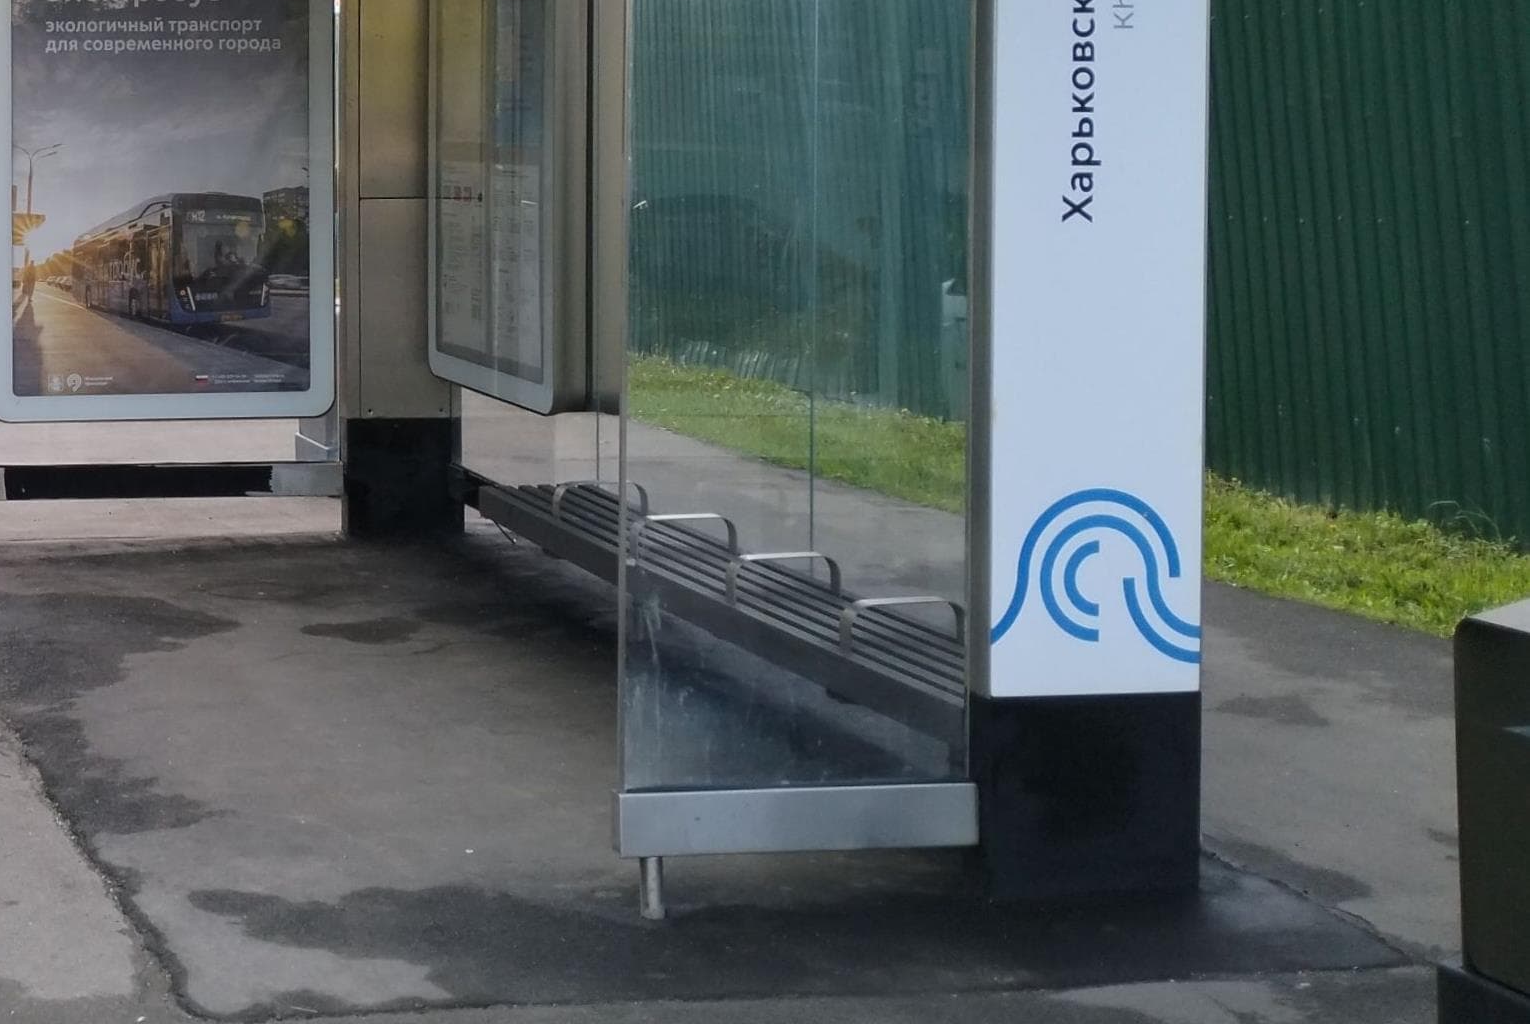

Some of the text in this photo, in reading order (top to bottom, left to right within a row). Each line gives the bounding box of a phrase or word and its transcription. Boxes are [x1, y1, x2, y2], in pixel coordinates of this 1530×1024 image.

[45, 17, 262, 34] экологичный транспорт
[45, 37, 282, 54] для современного города
